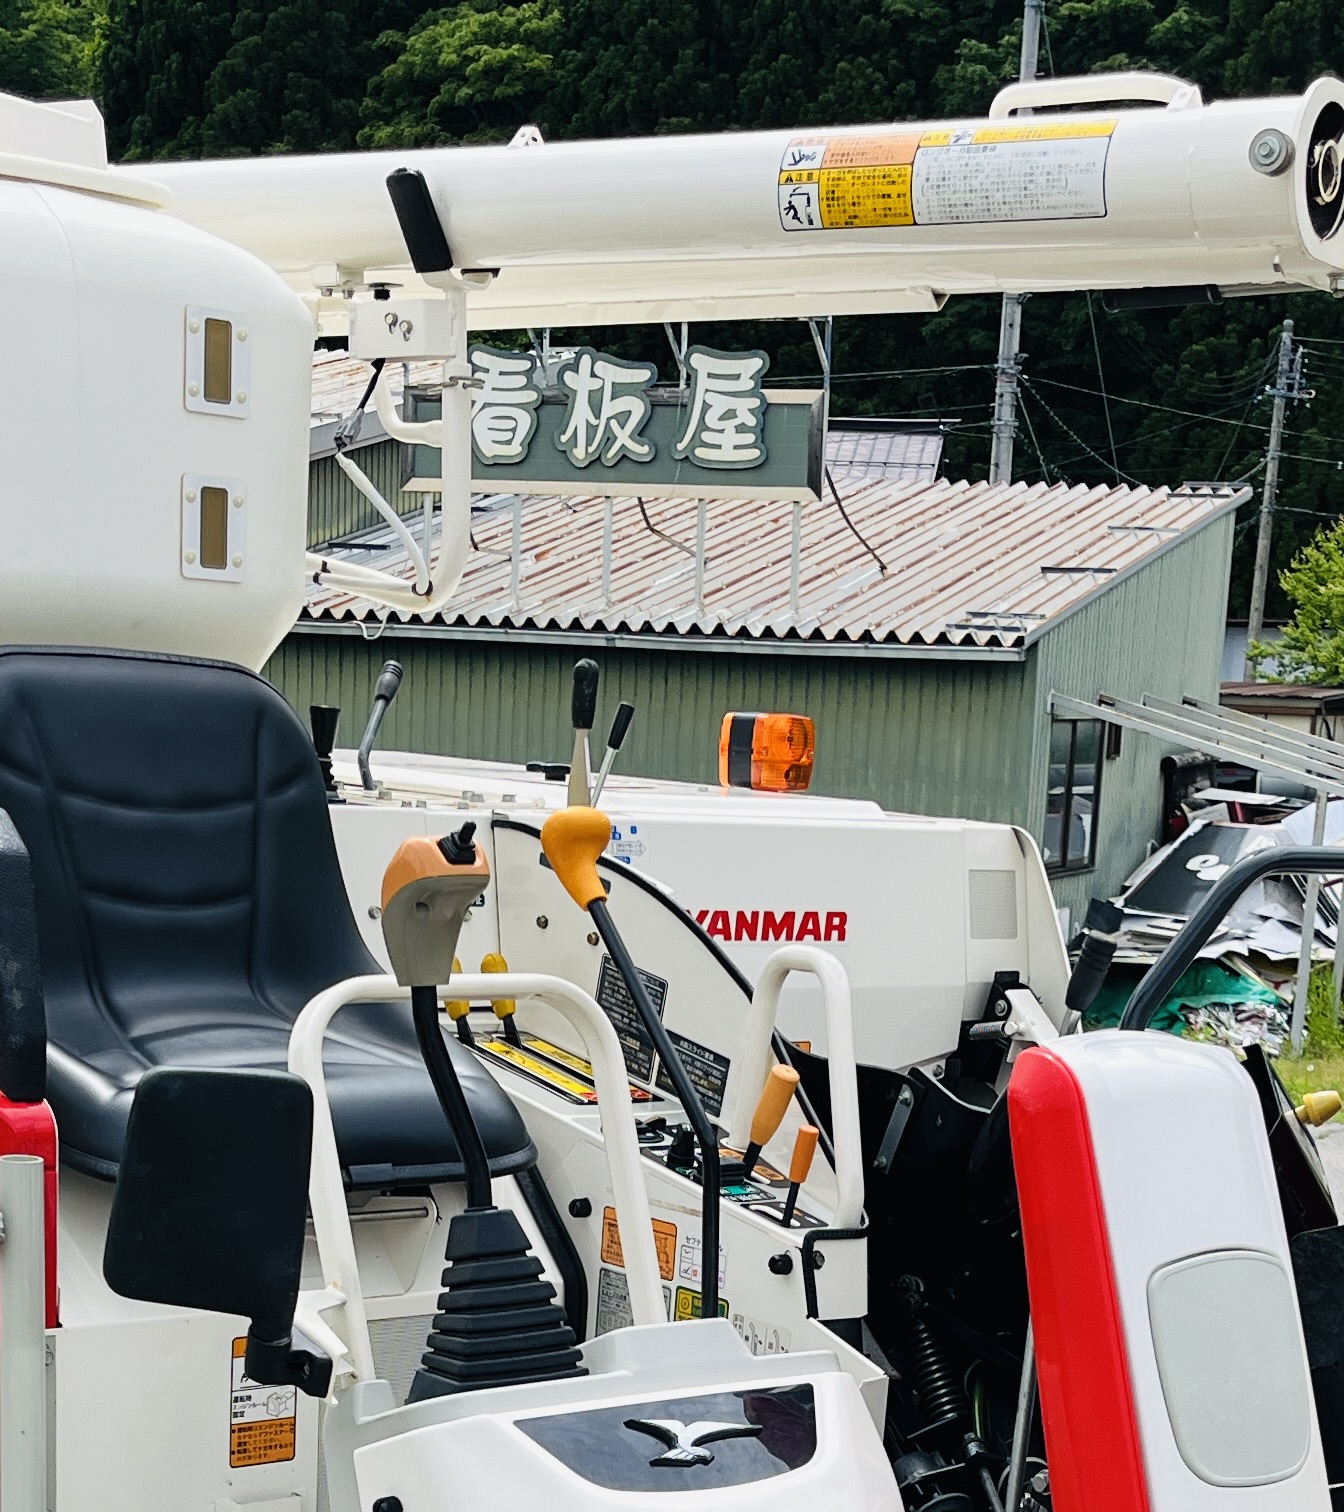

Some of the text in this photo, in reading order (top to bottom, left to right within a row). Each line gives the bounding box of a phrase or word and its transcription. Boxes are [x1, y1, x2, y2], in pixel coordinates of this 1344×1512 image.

[471, 348, 765, 463] 看板屋
[688, 909, 848, 942] YANMAR
